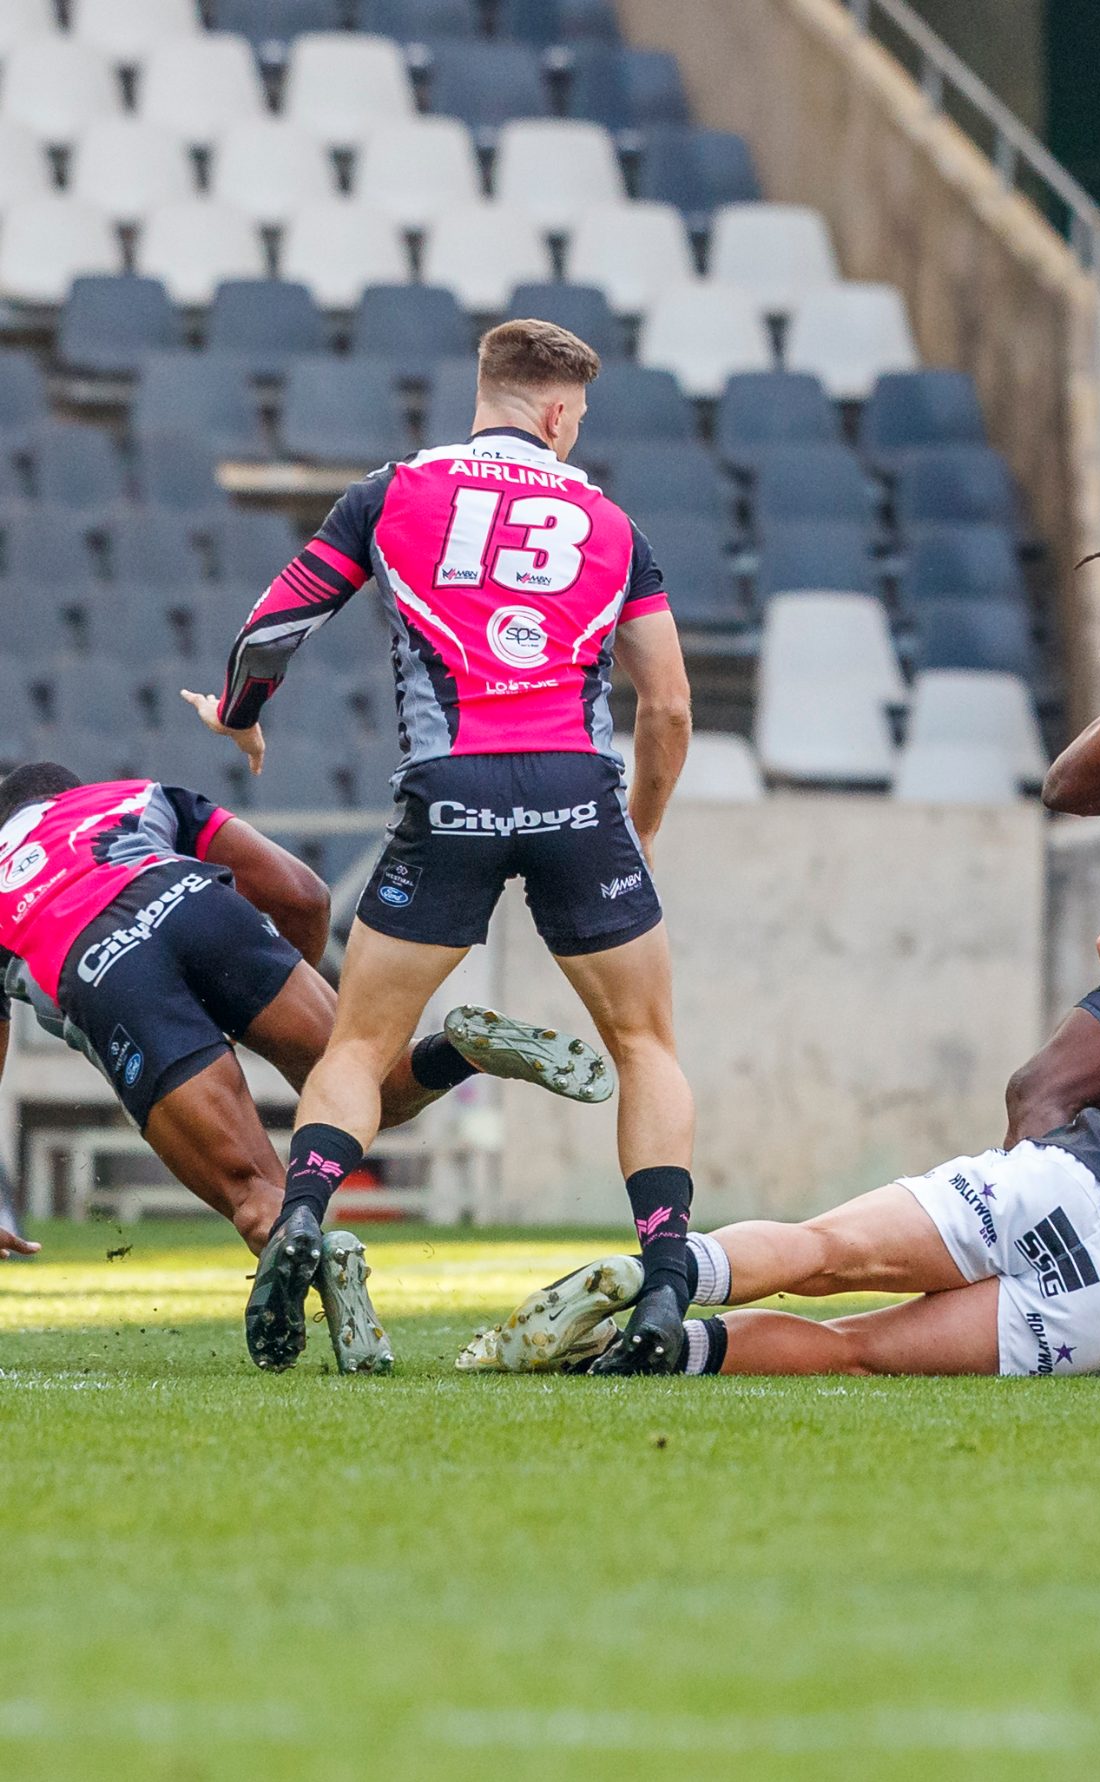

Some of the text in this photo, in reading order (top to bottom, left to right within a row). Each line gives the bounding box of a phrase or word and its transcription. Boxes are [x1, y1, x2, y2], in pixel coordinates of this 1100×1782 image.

[448, 460, 568, 492] AIRLINK
[434, 487, 593, 594] 13
[505, 627, 541, 645] sps
[429, 800, 599, 836] Citybug
[77, 873, 212, 984] Citybug
